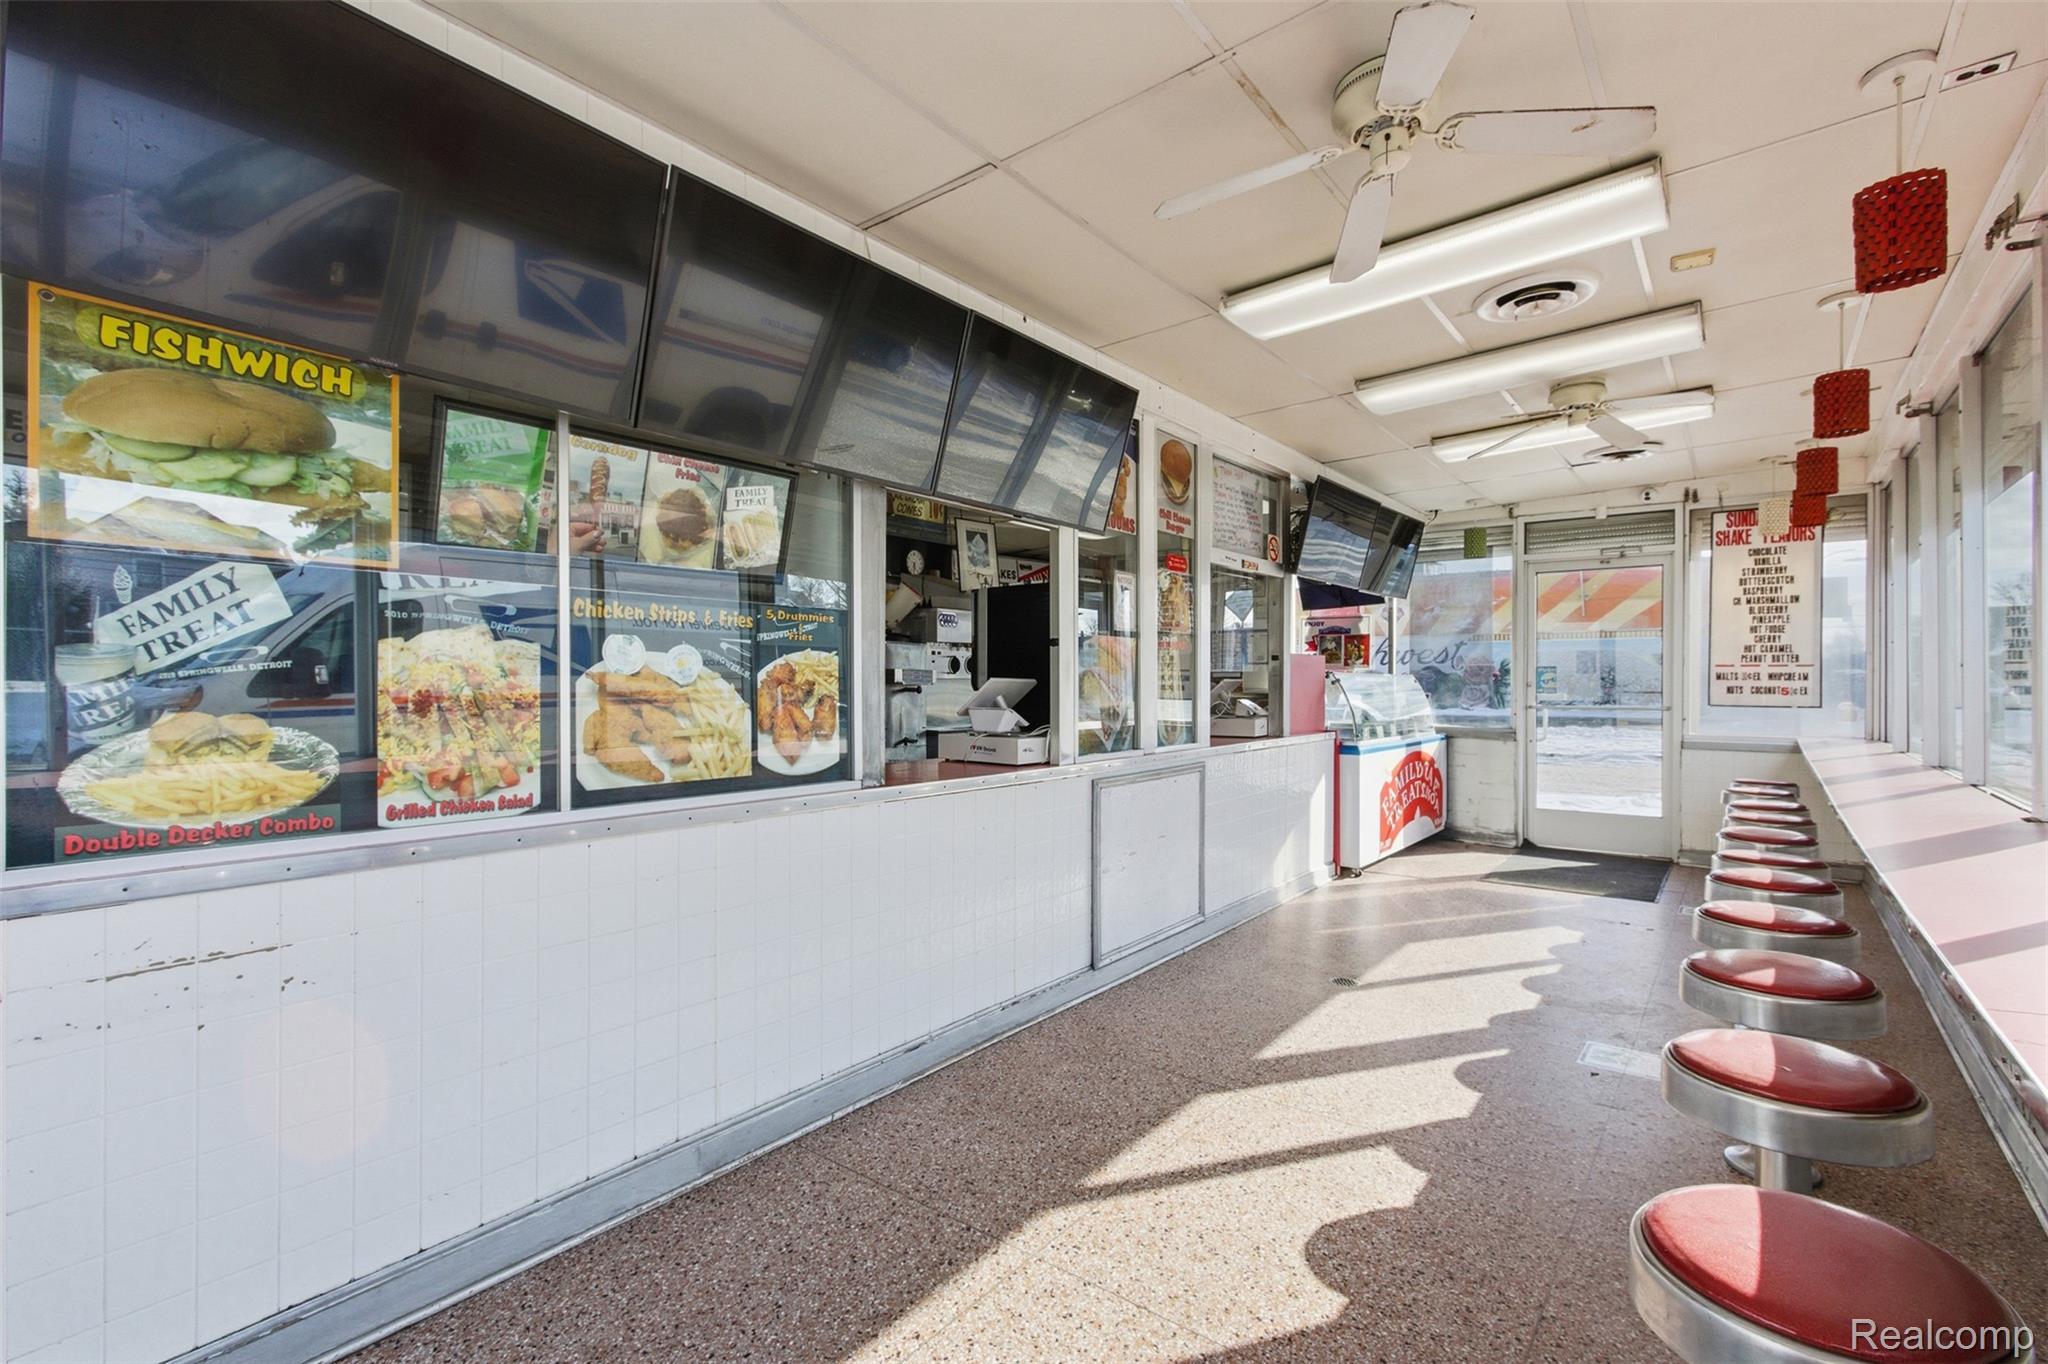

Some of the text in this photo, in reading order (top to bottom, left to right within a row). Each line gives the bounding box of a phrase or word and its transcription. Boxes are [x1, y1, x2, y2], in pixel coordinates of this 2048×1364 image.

[99, 312, 353, 397] FISHWICH
[570, 435, 638, 461] Corndog
[675, 467, 701, 482] Fries
[734, 488, 768, 498] FAMILY
[735, 498, 767, 508] TREAT
[1726, 511, 1759, 528] SUND
[1715, 529, 1752, 546] SHAKE
[1748, 546, 1787, 556] CHOCOLATE
[1754, 556, 1781, 566] VANILLA
[1742, 566, 1788, 576] STRAWBERRY
[1739, 576, 1795, 586] BUTTERSCOTCH
[1743, 586, 1783, 596] RASPBERRY
[117, 566, 241, 638] FAMILY
[1746, 595, 1800, 605] MARSHMALLOW
[572, 597, 644, 621] Chicken
[649, 602, 697, 626] Strips
[719, 610, 753, 628] Fries
[765, 607, 835, 623] 5 Drummies
[1749, 605, 1788, 615] BLUEBERRY
[1752, 615, 1790, 624] PINEAPPLE
[136, 598, 256, 663] TREAT
[1749, 625, 1786, 634] HOT FUDGE
[1754, 635, 1782, 644] CHERRY
[1744, 644, 1793, 653] HOT CARAMEL
[1741, 654, 1800, 663] PEANUT BUTTER
[249, 660, 293, 671] DETROIT
[1715, 672, 1739, 681] MALTS
[1726, 686, 1743, 695] NUTS
[385, 792, 535, 822] Grilled Chicken Salad
[63, 812, 335, 856] Double Decker Combo
